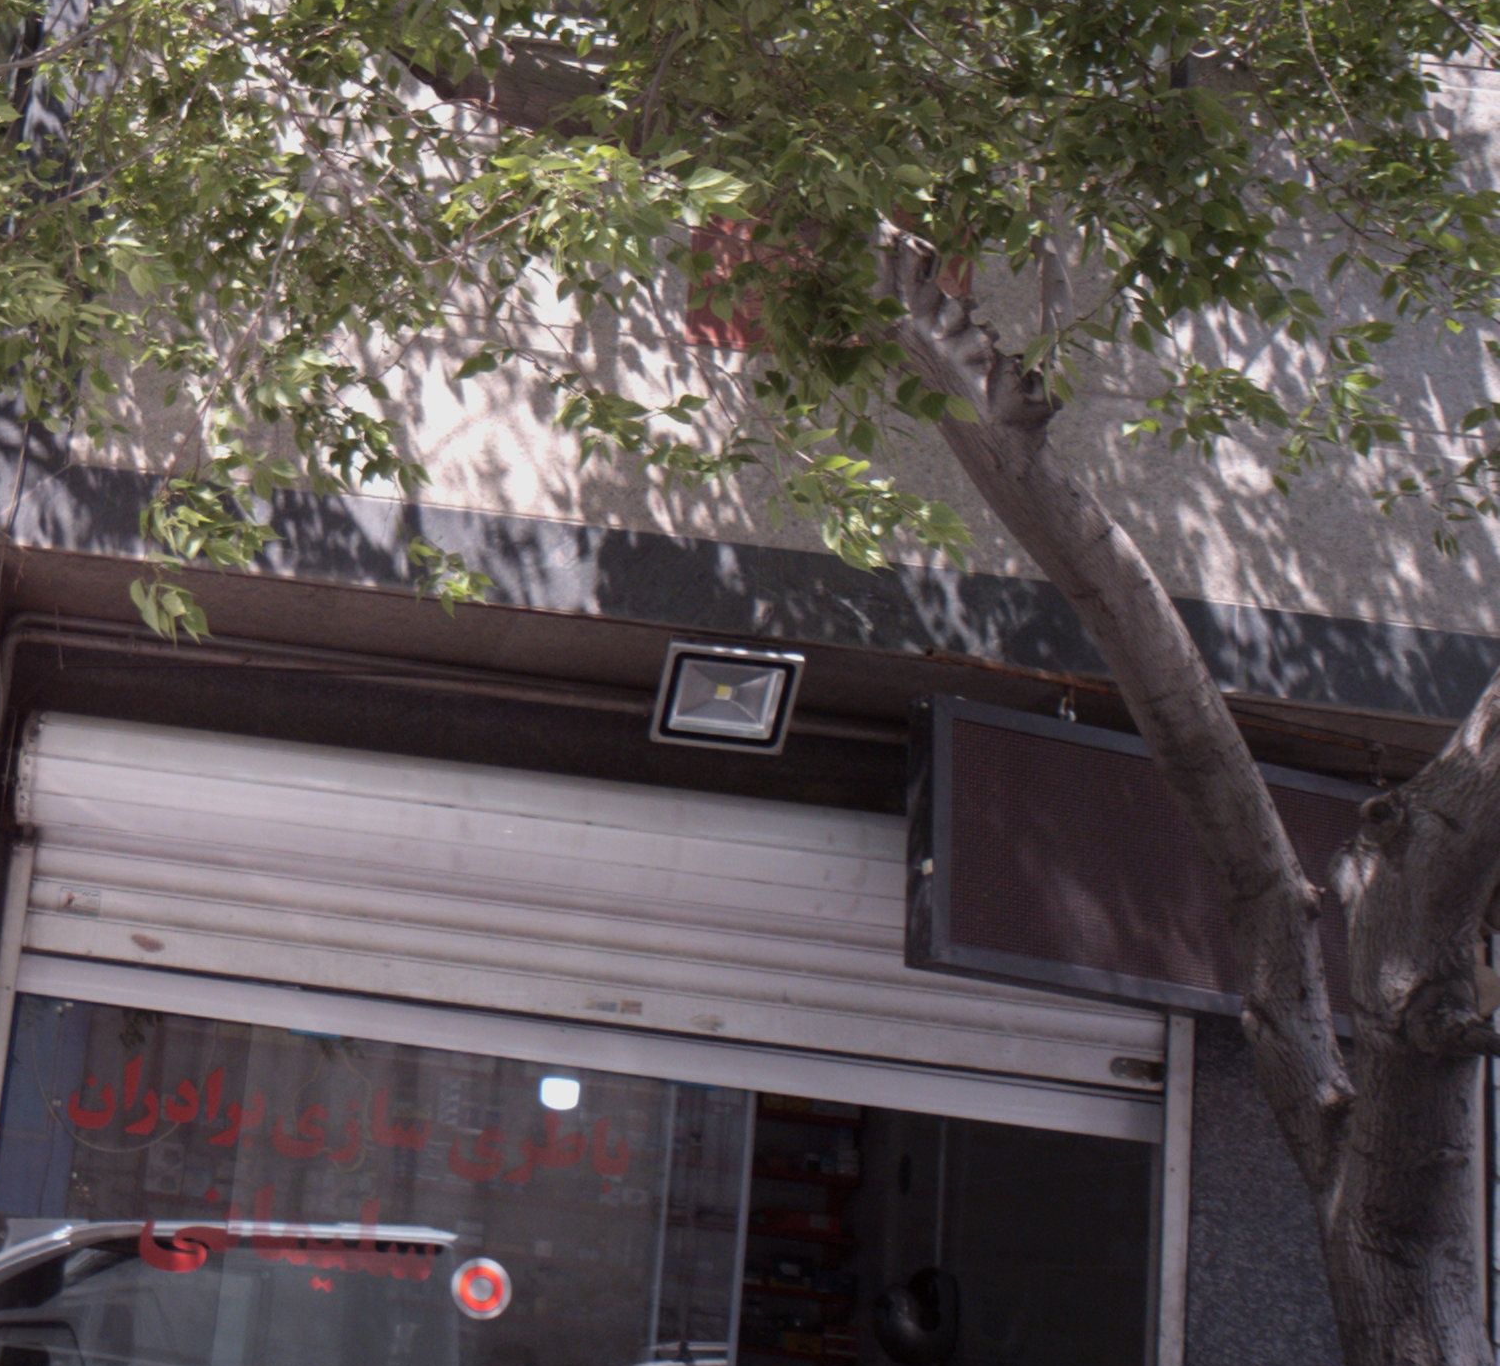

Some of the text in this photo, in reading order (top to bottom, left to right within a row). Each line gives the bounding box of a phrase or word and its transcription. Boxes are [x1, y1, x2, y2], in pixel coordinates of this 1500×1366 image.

[66, 1053, 633, 1196] باطری سازی برادران
[138, 1183, 436, 1294] سلیمانی
